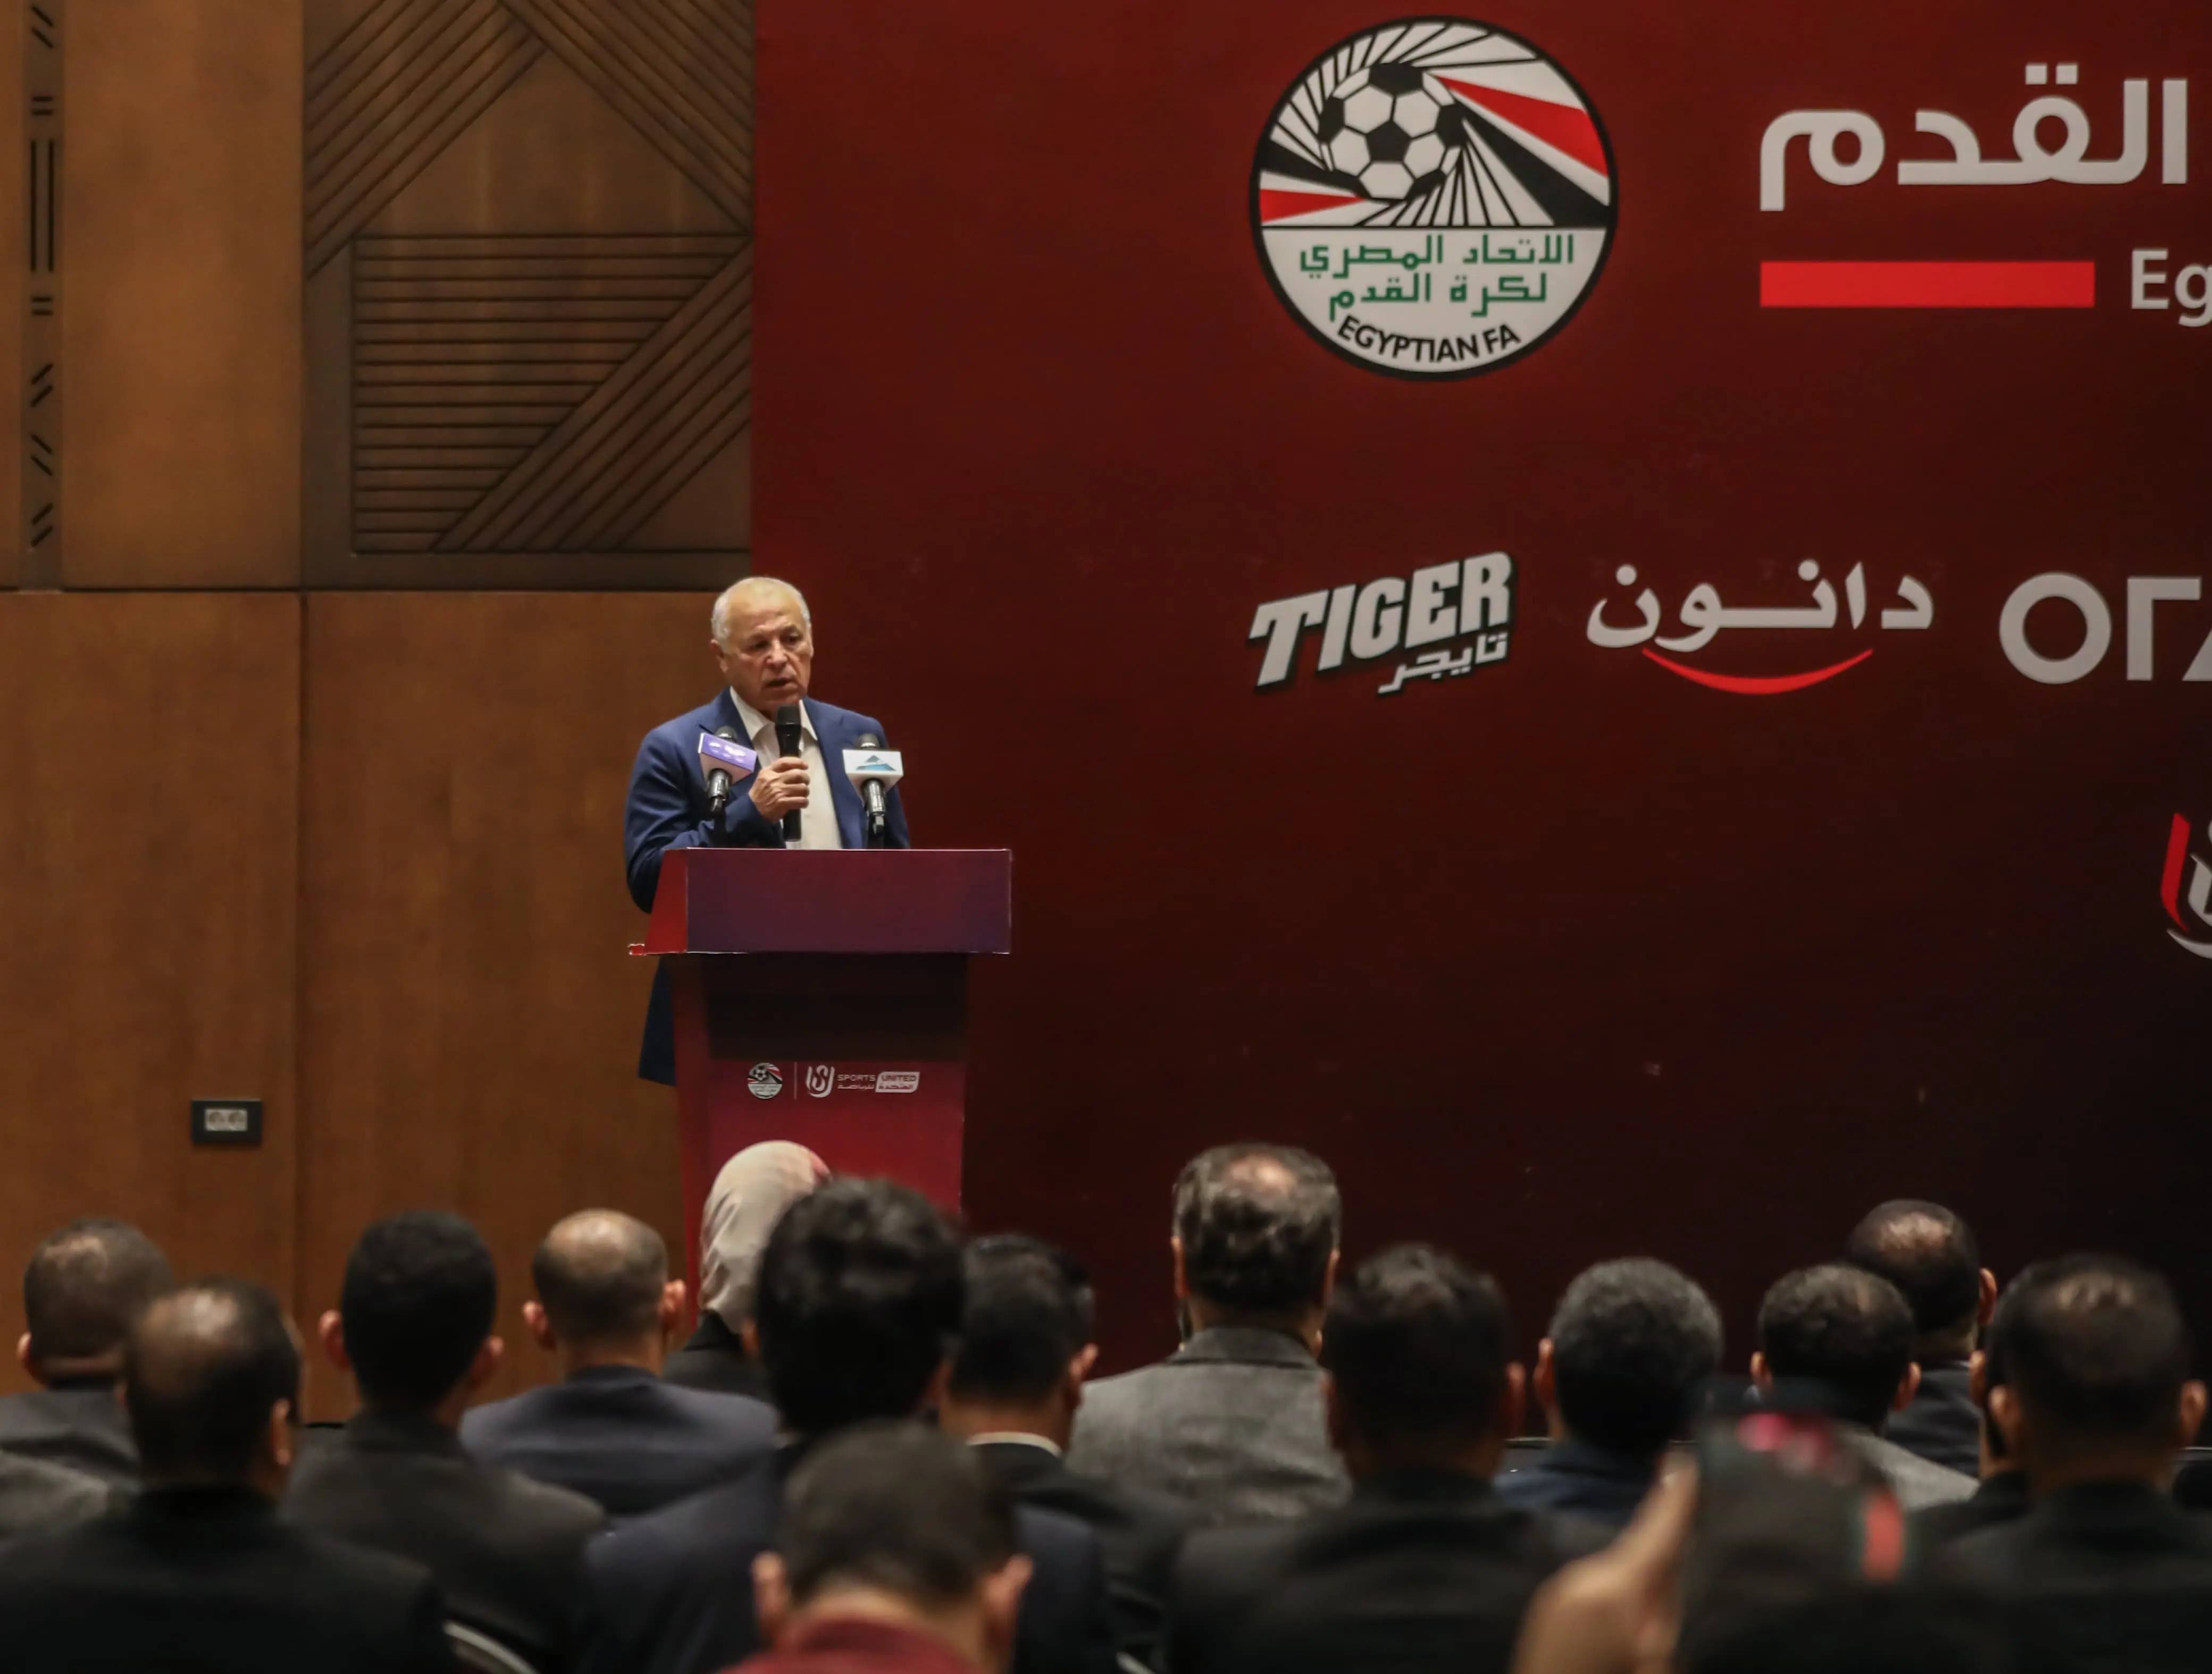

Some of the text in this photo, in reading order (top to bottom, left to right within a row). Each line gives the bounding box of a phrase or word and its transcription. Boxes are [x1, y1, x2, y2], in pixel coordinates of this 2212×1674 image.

[1759, 62, 2188, 212] القدم
[1300, 234, 1573, 280] الاتحاد المصري
[1329, 272, 1547, 322] لكرة القدم
[1337, 314, 1521, 363] EGYPTIAN FA
[1249, 551, 1512, 687] TIGER
[1586, 559, 1933, 653] دانون
[1377, 632, 1508, 694] تايجر
